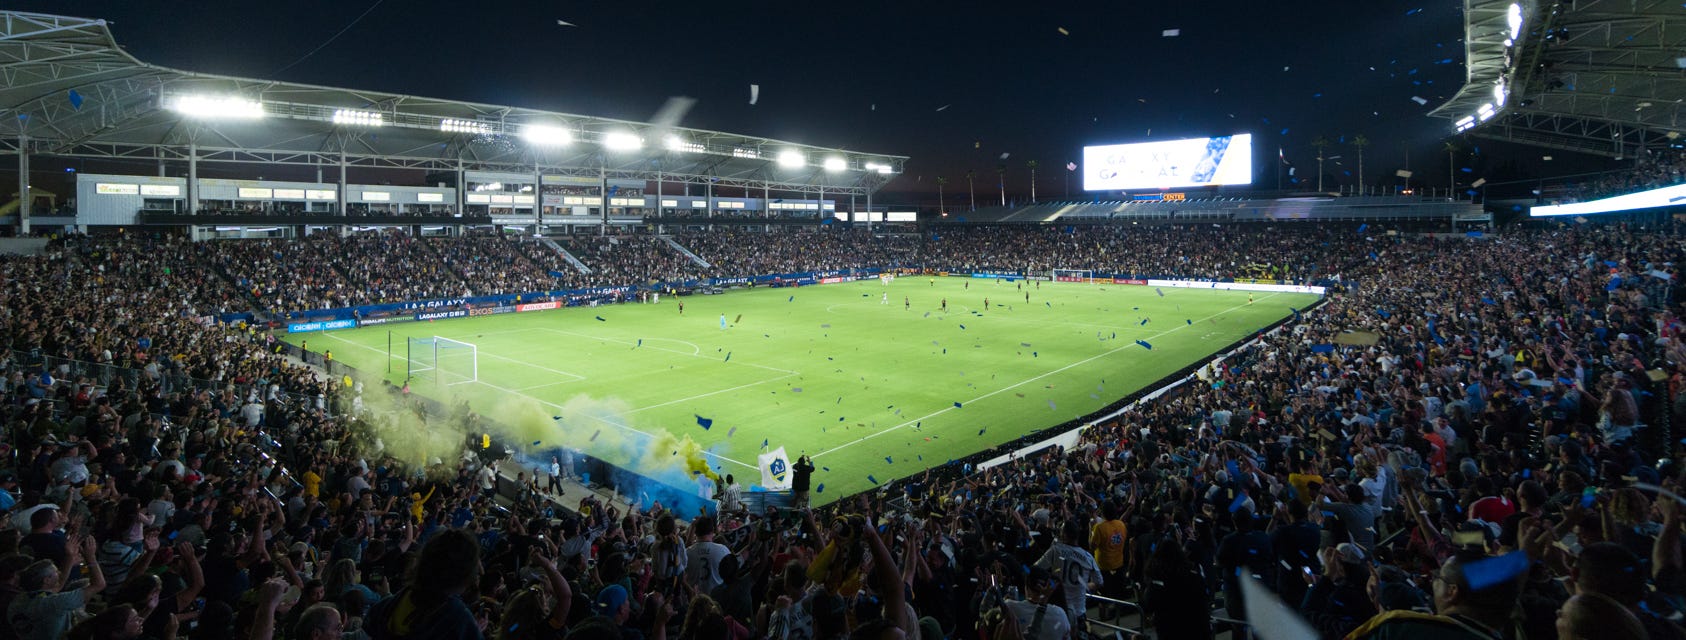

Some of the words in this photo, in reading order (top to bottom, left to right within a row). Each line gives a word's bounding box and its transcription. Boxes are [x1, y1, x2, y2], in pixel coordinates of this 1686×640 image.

[419, 311, 449, 320] LAGALAXY
[469, 307, 494, 316] EXOS
[1062, 559, 1084, 584] 10
